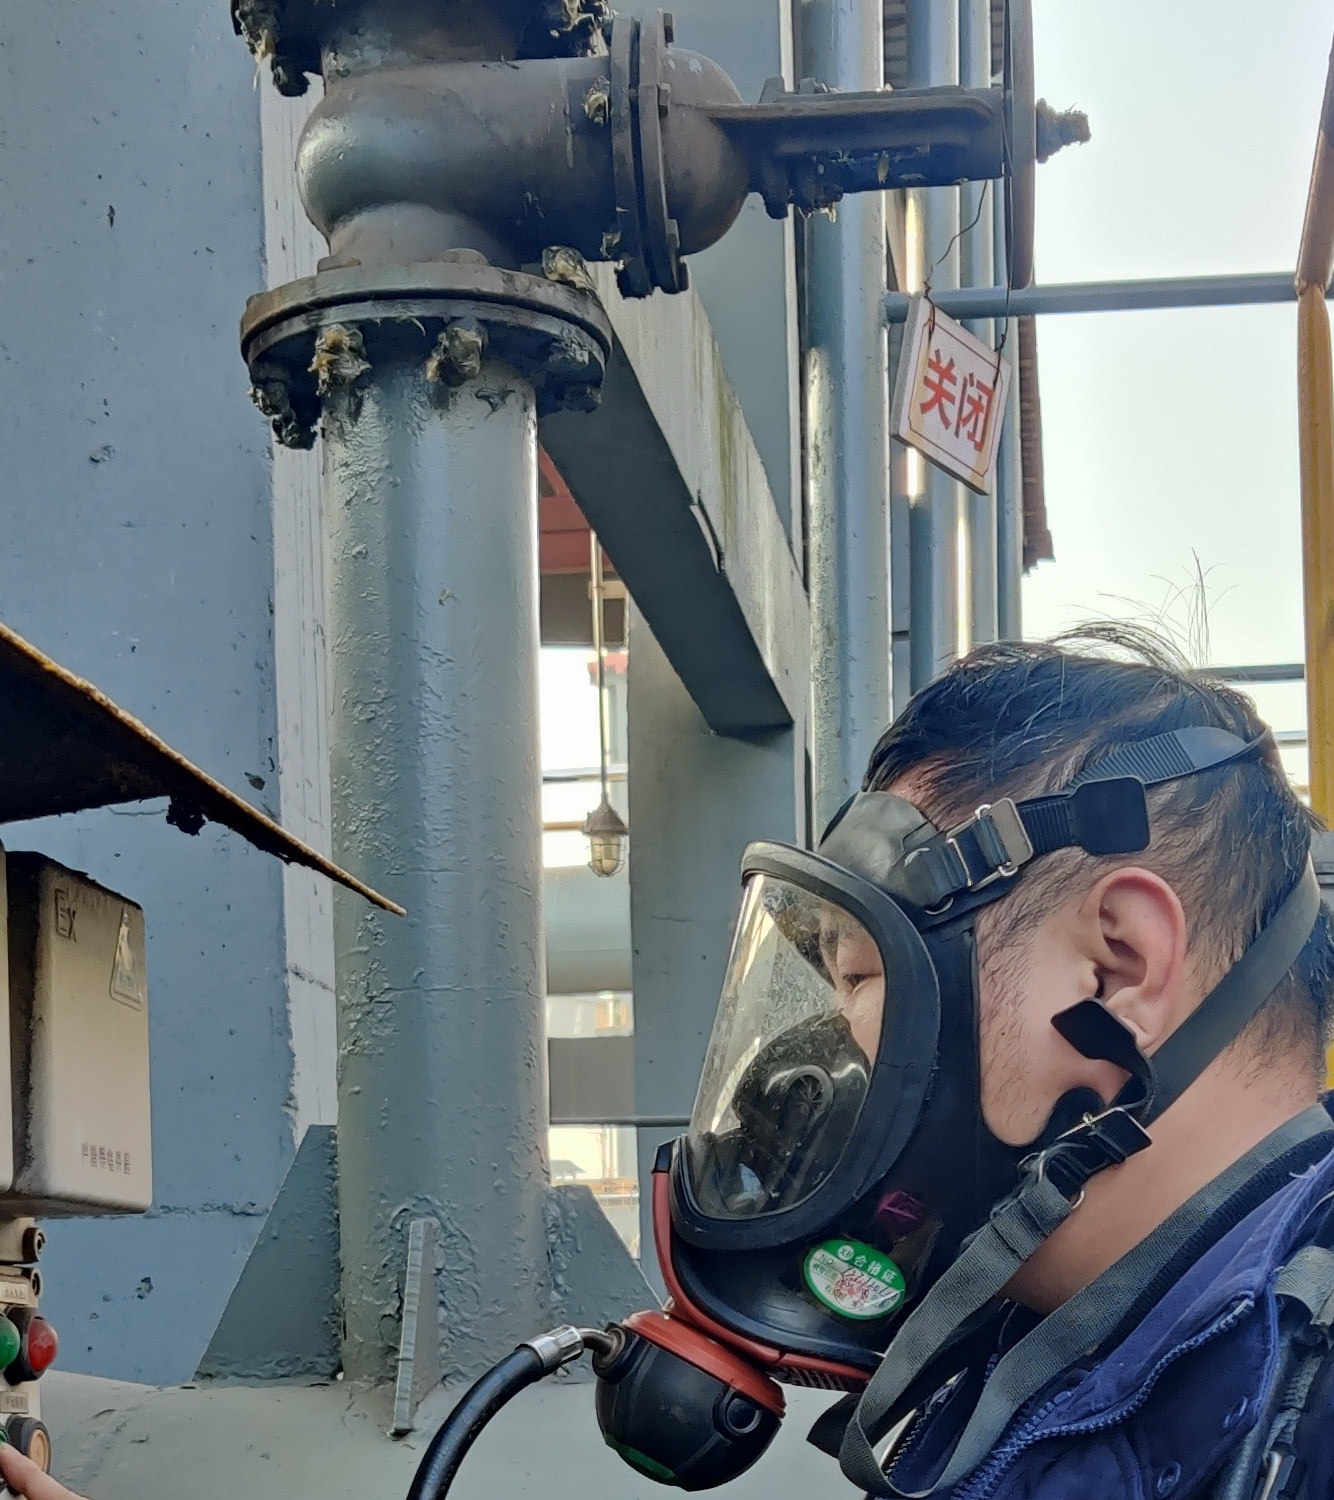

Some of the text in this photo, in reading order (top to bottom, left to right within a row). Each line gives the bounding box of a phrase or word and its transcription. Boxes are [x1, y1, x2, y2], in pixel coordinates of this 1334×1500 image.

[921, 348, 996, 452] 关闭
[853, 1254, 898, 1284] 合格证
